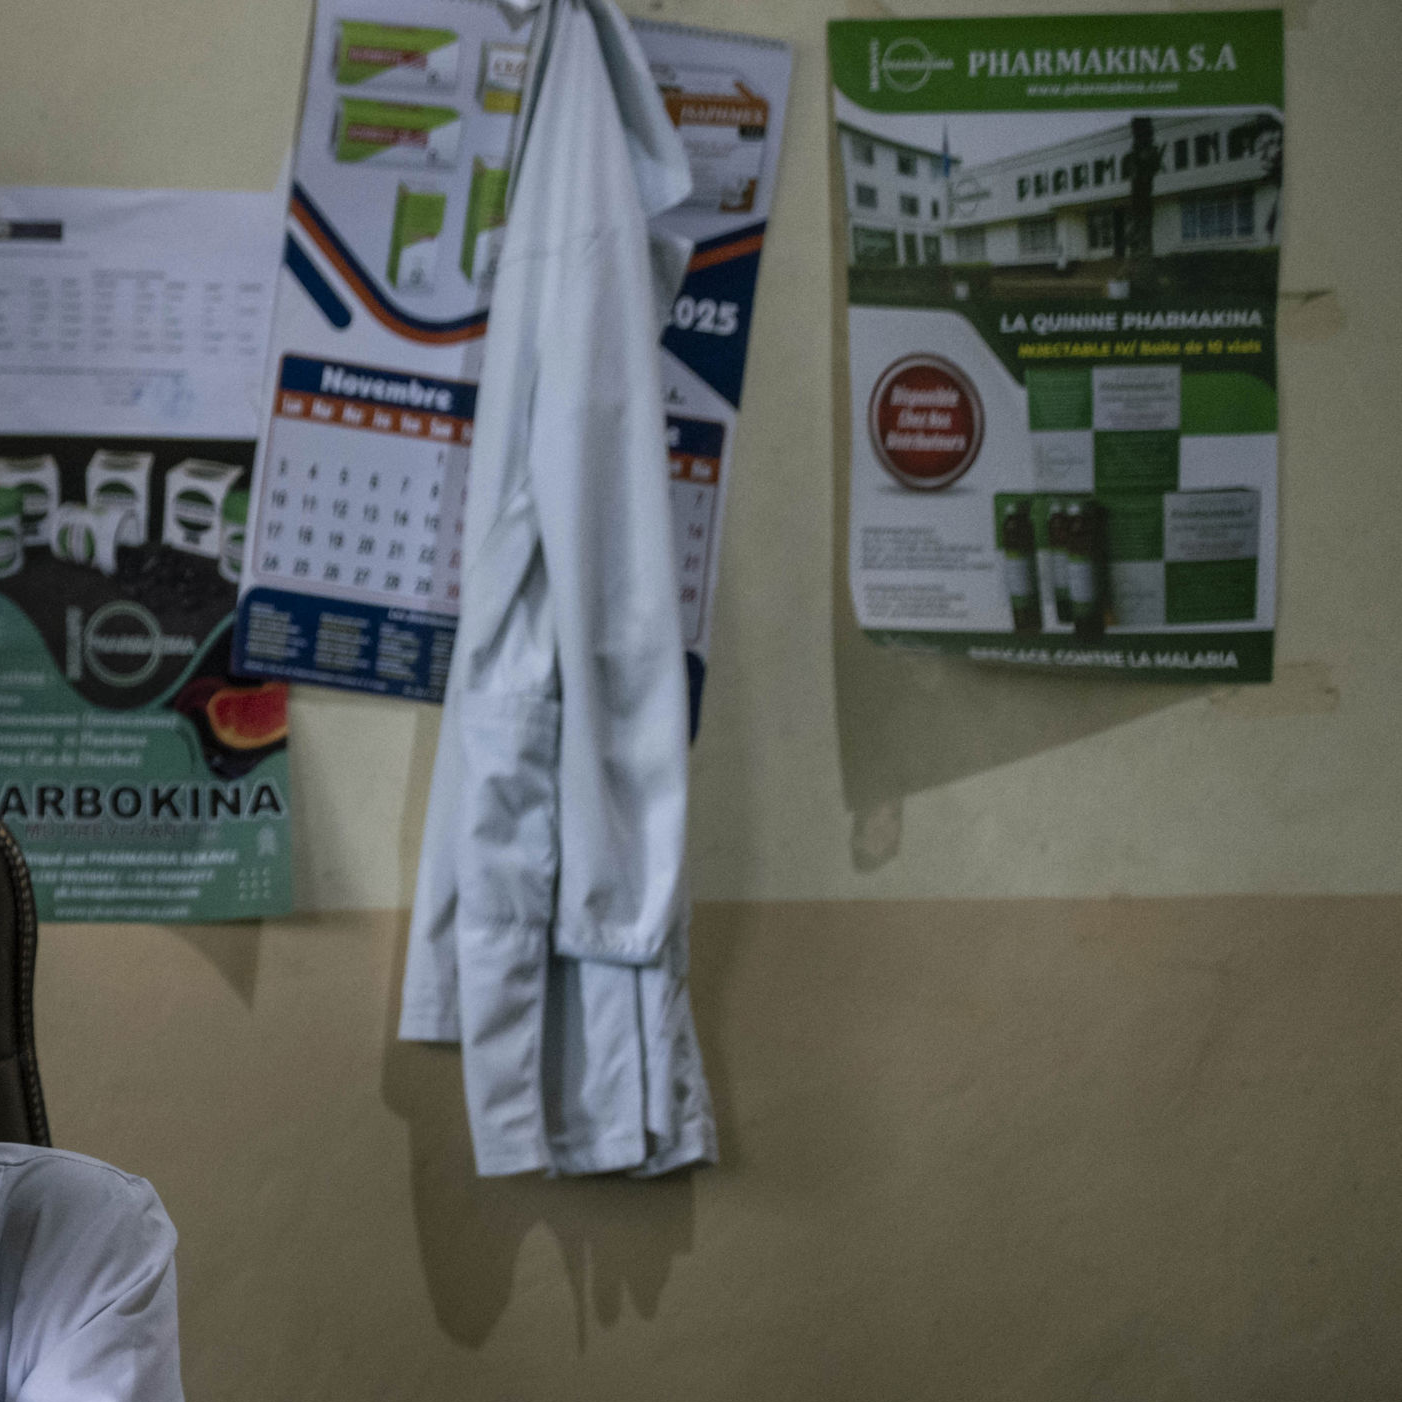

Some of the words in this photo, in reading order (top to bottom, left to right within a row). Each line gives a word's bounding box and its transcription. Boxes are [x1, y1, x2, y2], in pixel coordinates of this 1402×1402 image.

[968, 48, 1180, 77] PHARMAKINA
[1187, 43, 1238, 72] S.A
[673, 294, 741, 337] 025
[999, 312, 1028, 334] LA
[1031, 312, 1118, 335] QUININE
[1121, 309, 1263, 331] PHARMAKINA
[320, 365, 453, 410] Novembre
[1054, 648, 1125, 668] CONTRE
[1127, 650, 1154, 668] LA
[1154, 649, 1239, 670] MALARIA
